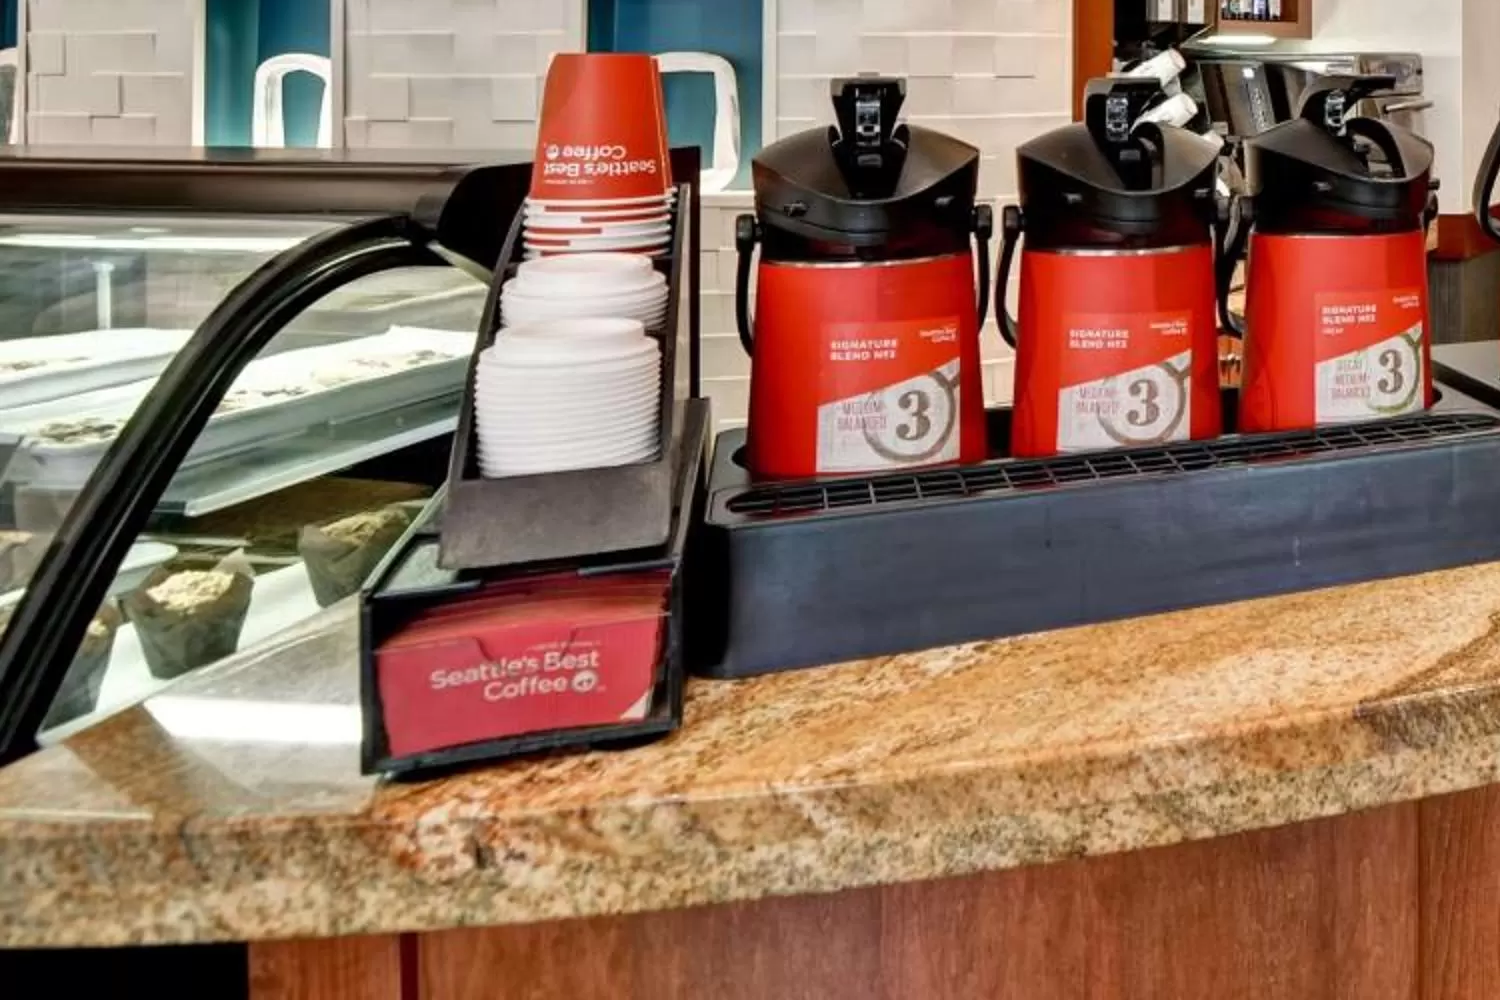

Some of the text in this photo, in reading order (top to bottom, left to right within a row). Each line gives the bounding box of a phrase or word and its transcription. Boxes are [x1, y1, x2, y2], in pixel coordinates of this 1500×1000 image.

[562, 144, 627, 160] Coffee
[543, 159, 656, 177] Seattle's Best
[1322, 304, 1377, 314] SIGNATURE
[1069, 328, 1129, 339] SIGNATURE
[830, 338, 898, 350] SIGNATURE
[1069, 339, 1103, 349] BLEND
[830, 350, 870, 361] BLEND
[1377, 349, 1404, 394] 3
[1126, 379, 1160, 426] 3
[895, 390, 931, 441] 3
[429, 649, 599, 690] Seattle's Best
[484, 676, 568, 701] Coffee
